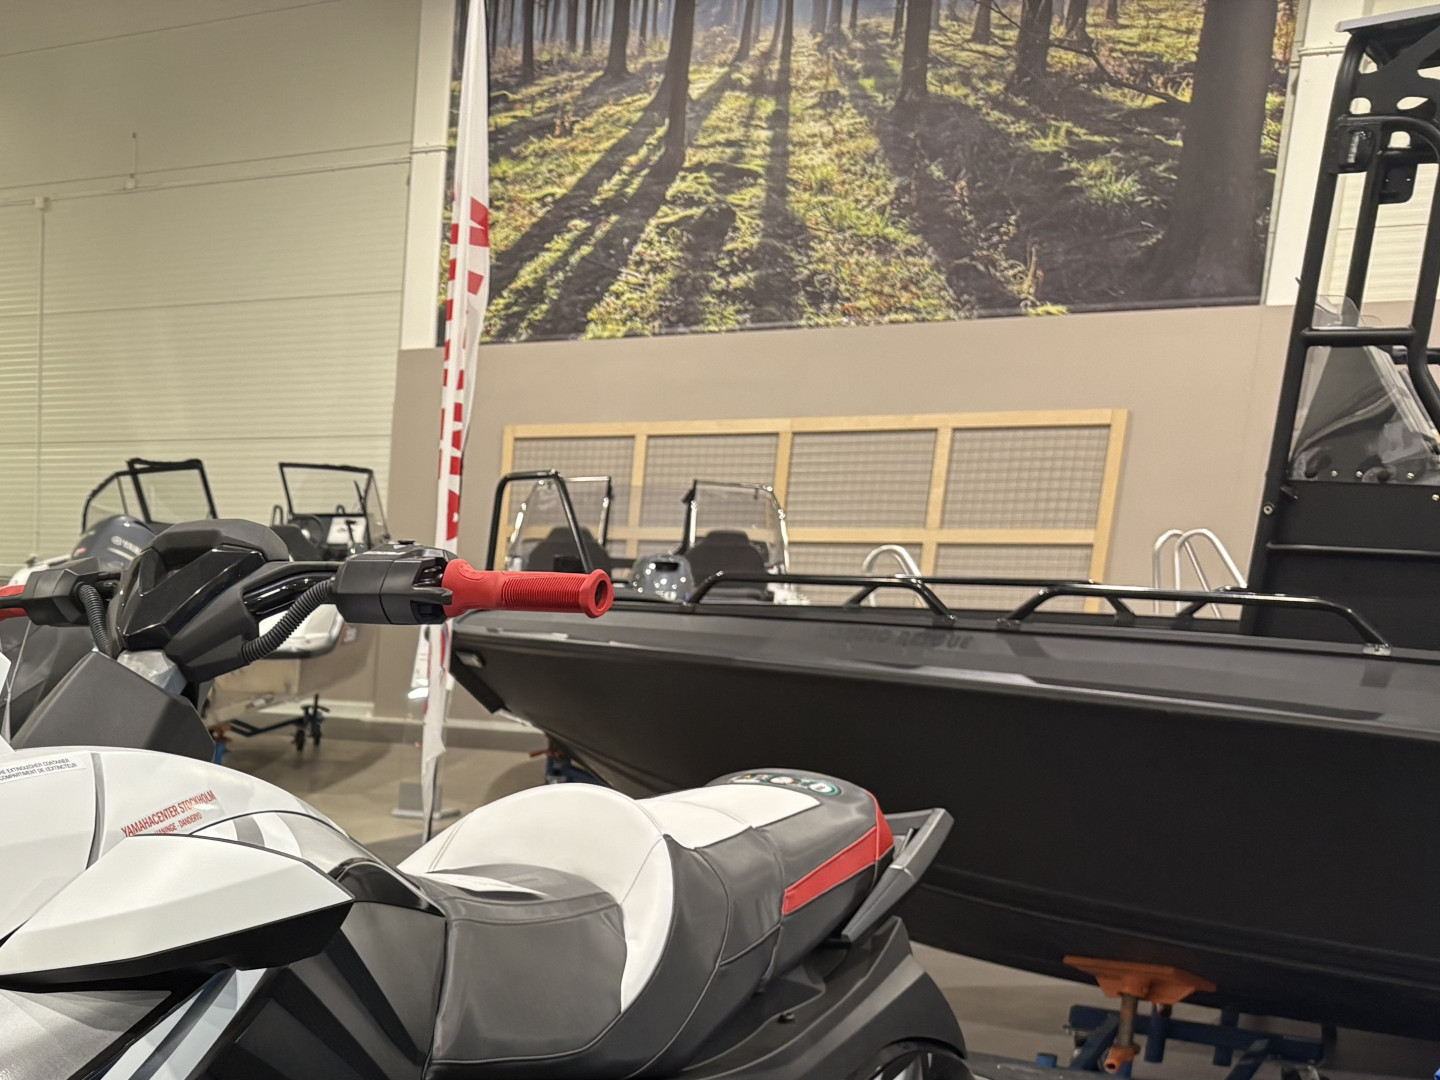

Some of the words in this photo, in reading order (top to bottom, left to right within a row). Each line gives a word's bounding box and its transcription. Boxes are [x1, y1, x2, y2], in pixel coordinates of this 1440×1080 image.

[121, 805, 181, 837] YAMAHACENTER
[178, 790, 217, 813] STOCKHOLM
[178, 811, 203, 828] DANDERYD
